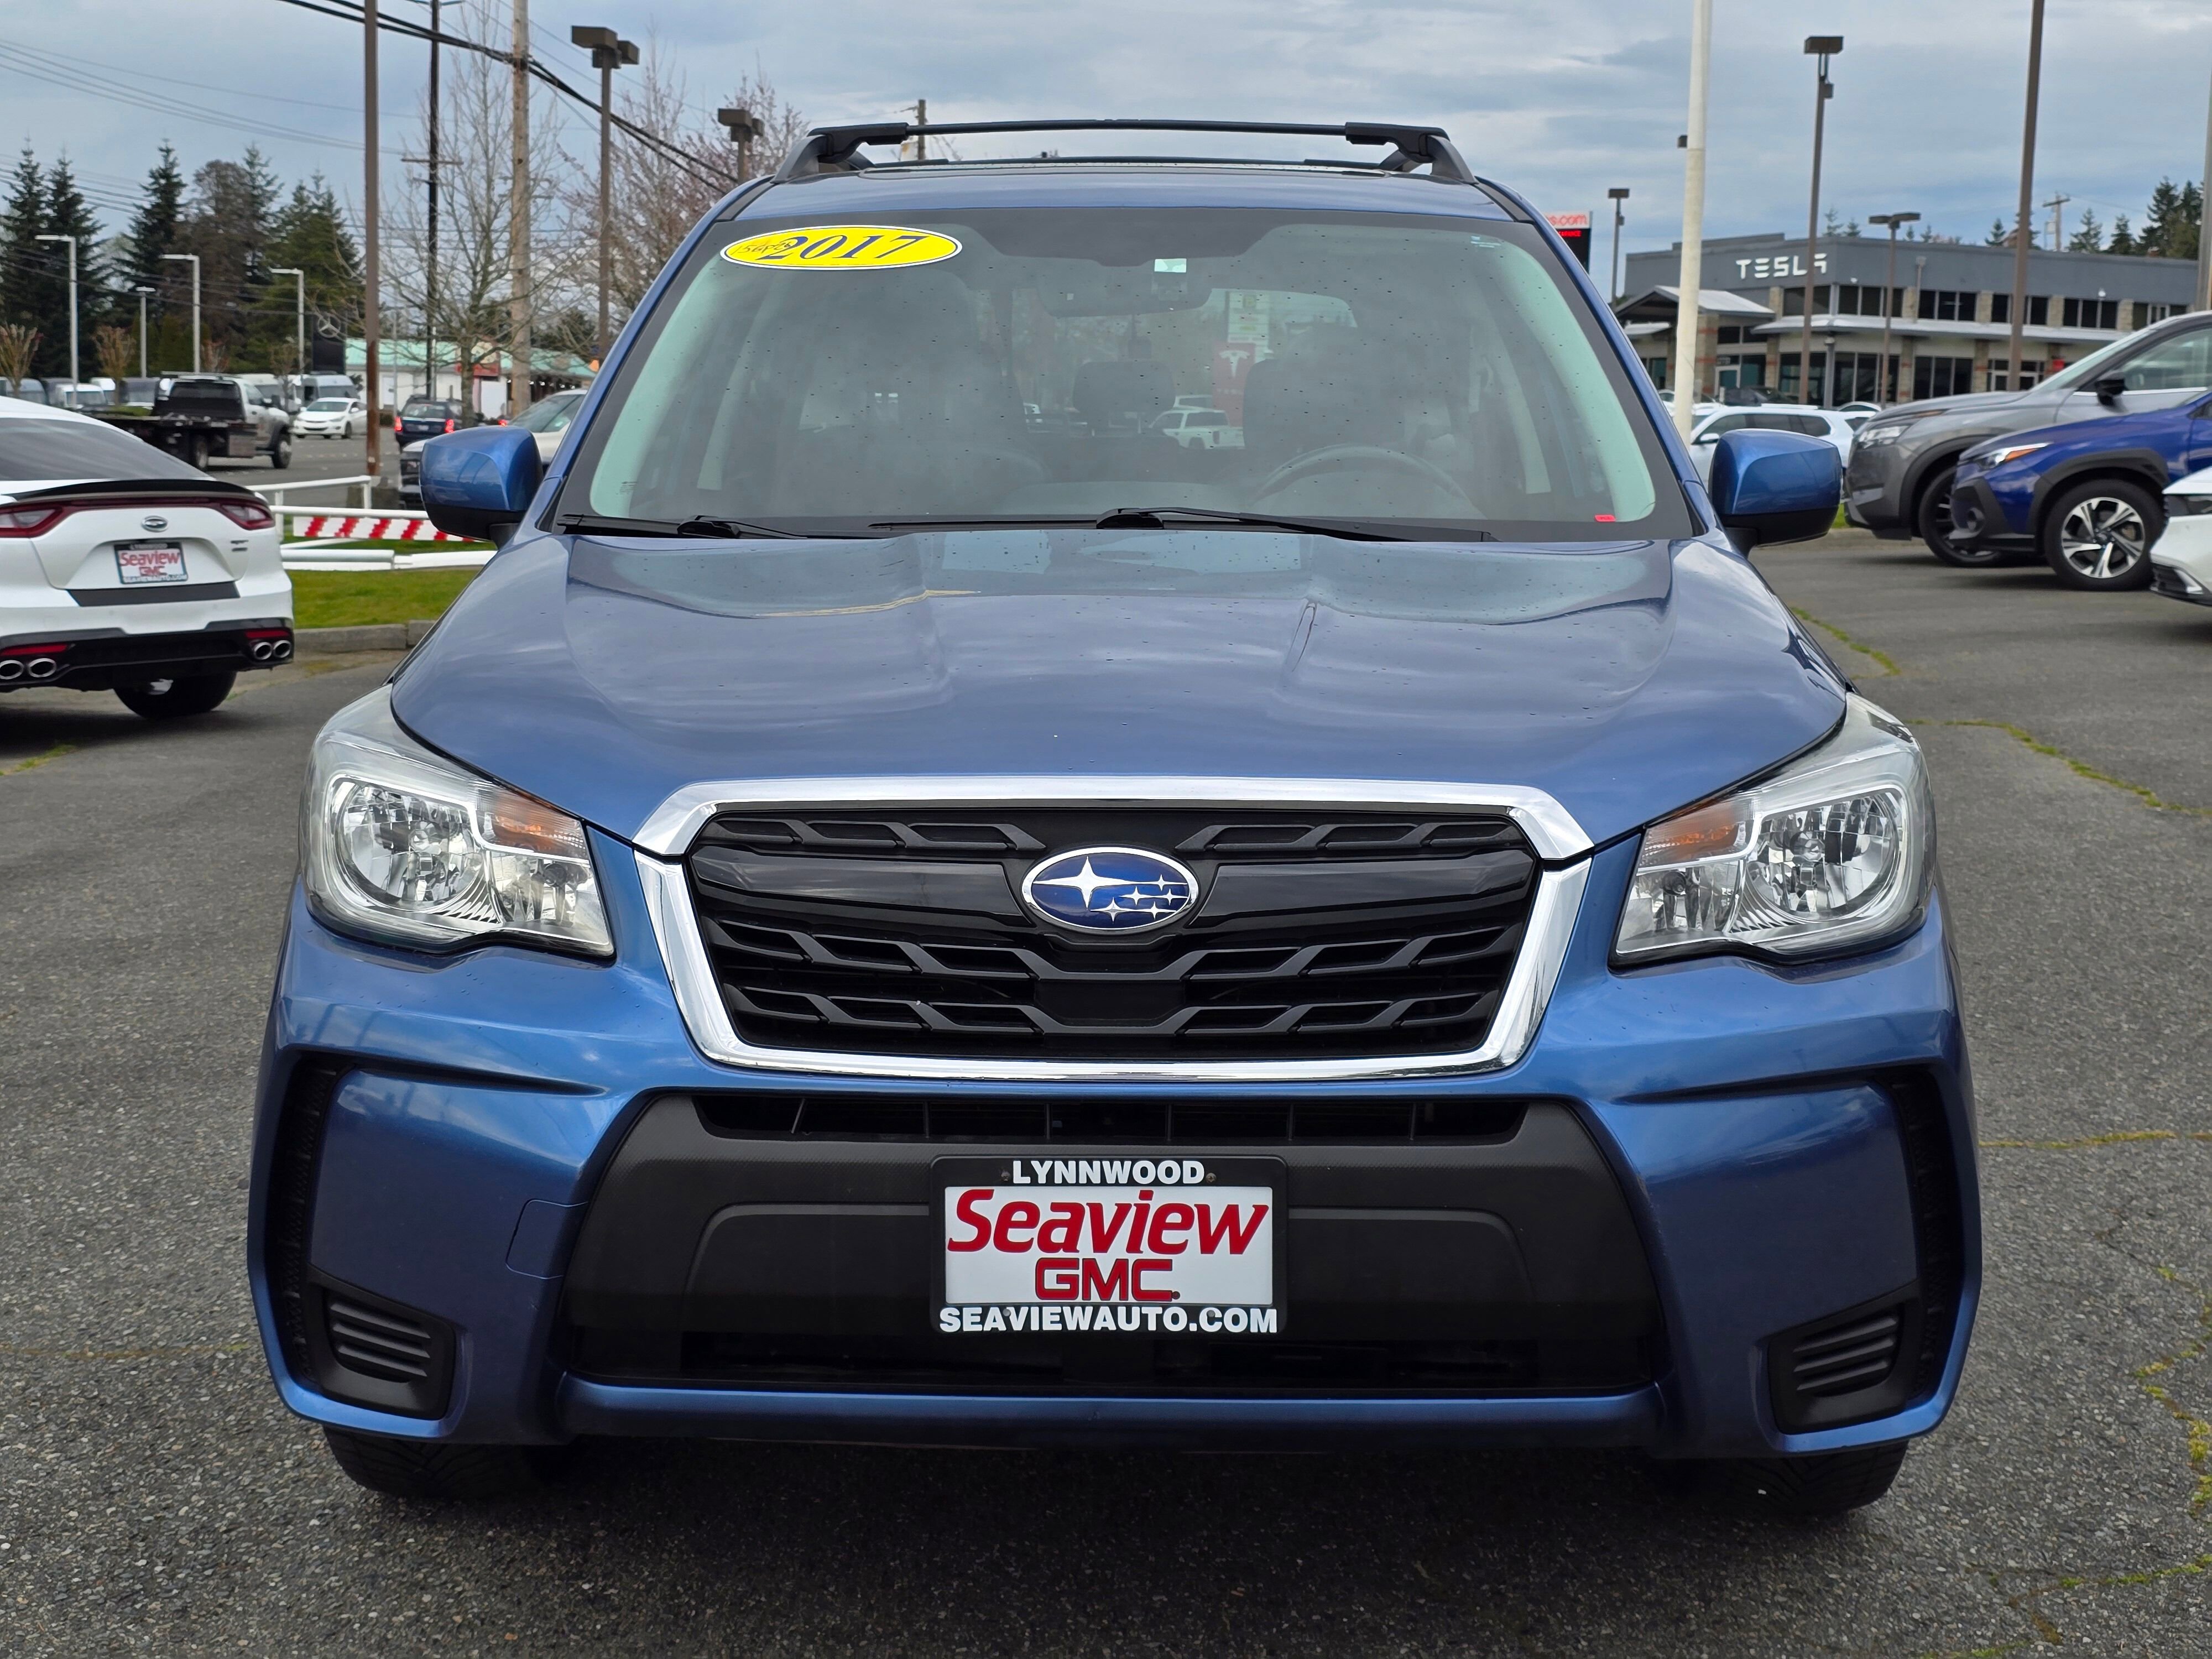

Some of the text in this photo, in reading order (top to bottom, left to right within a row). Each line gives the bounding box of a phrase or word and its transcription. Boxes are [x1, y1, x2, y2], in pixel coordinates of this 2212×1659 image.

[1546, 214, 1588, 226] s.com
[755, 234, 930, 260] 2017
[1736, 253, 1827, 279] TESLA
[120, 551, 180, 566] Seaview
[1013, 1160, 1204, 1185] LYNNWOOD
[947, 1189, 1269, 1255] Seaview
[1035, 1257, 1173, 1301] GMC
[940, 1306, 1277, 1333] SEAVIEWAUTO.COM
